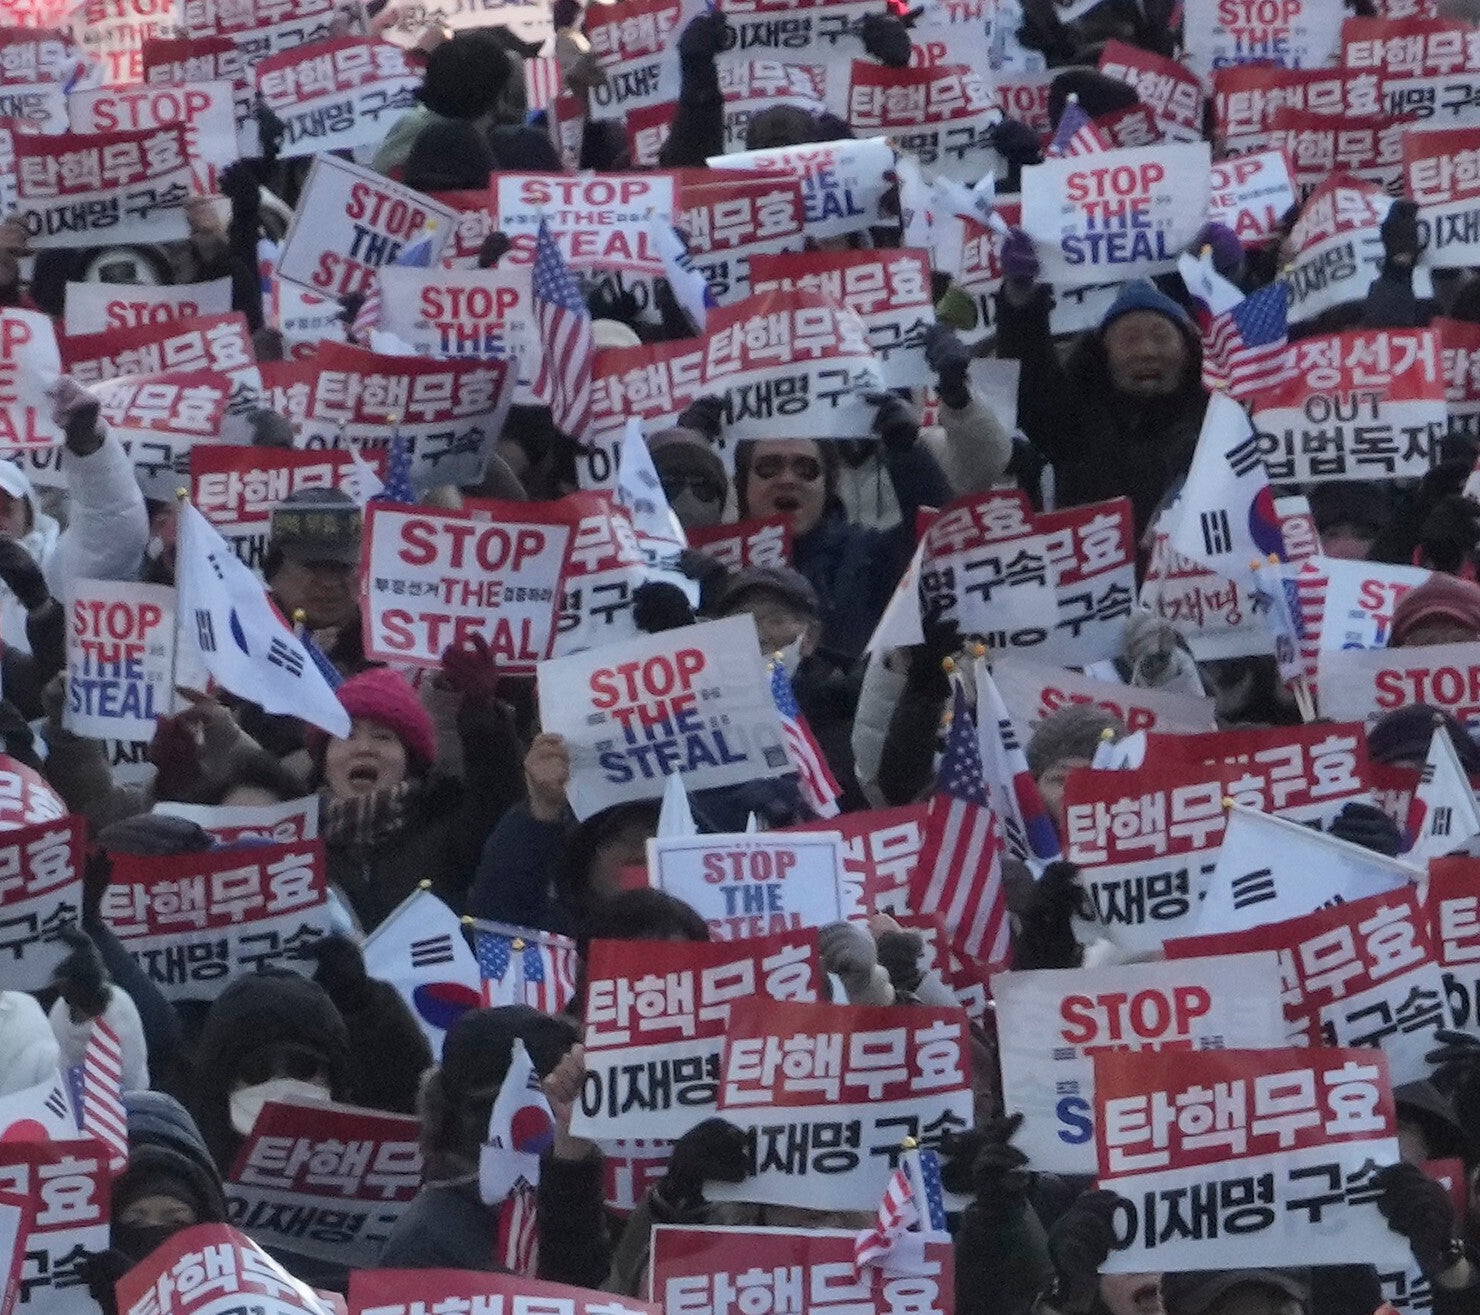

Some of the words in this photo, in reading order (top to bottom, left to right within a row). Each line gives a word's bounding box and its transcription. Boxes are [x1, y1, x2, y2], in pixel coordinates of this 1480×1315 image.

[1066, 161, 1165, 198] STOP
[1076, 201, 1152, 233] THE
[1062, 229, 1172, 264] STEAL
[1304, 391, 1380, 426] OUT
[1258, 422, 1440, 478] 입법독재
[725, 1023, 966, 1105] 탄핵무효
[1105, 1062, 1390, 1171] 탄핵무효
